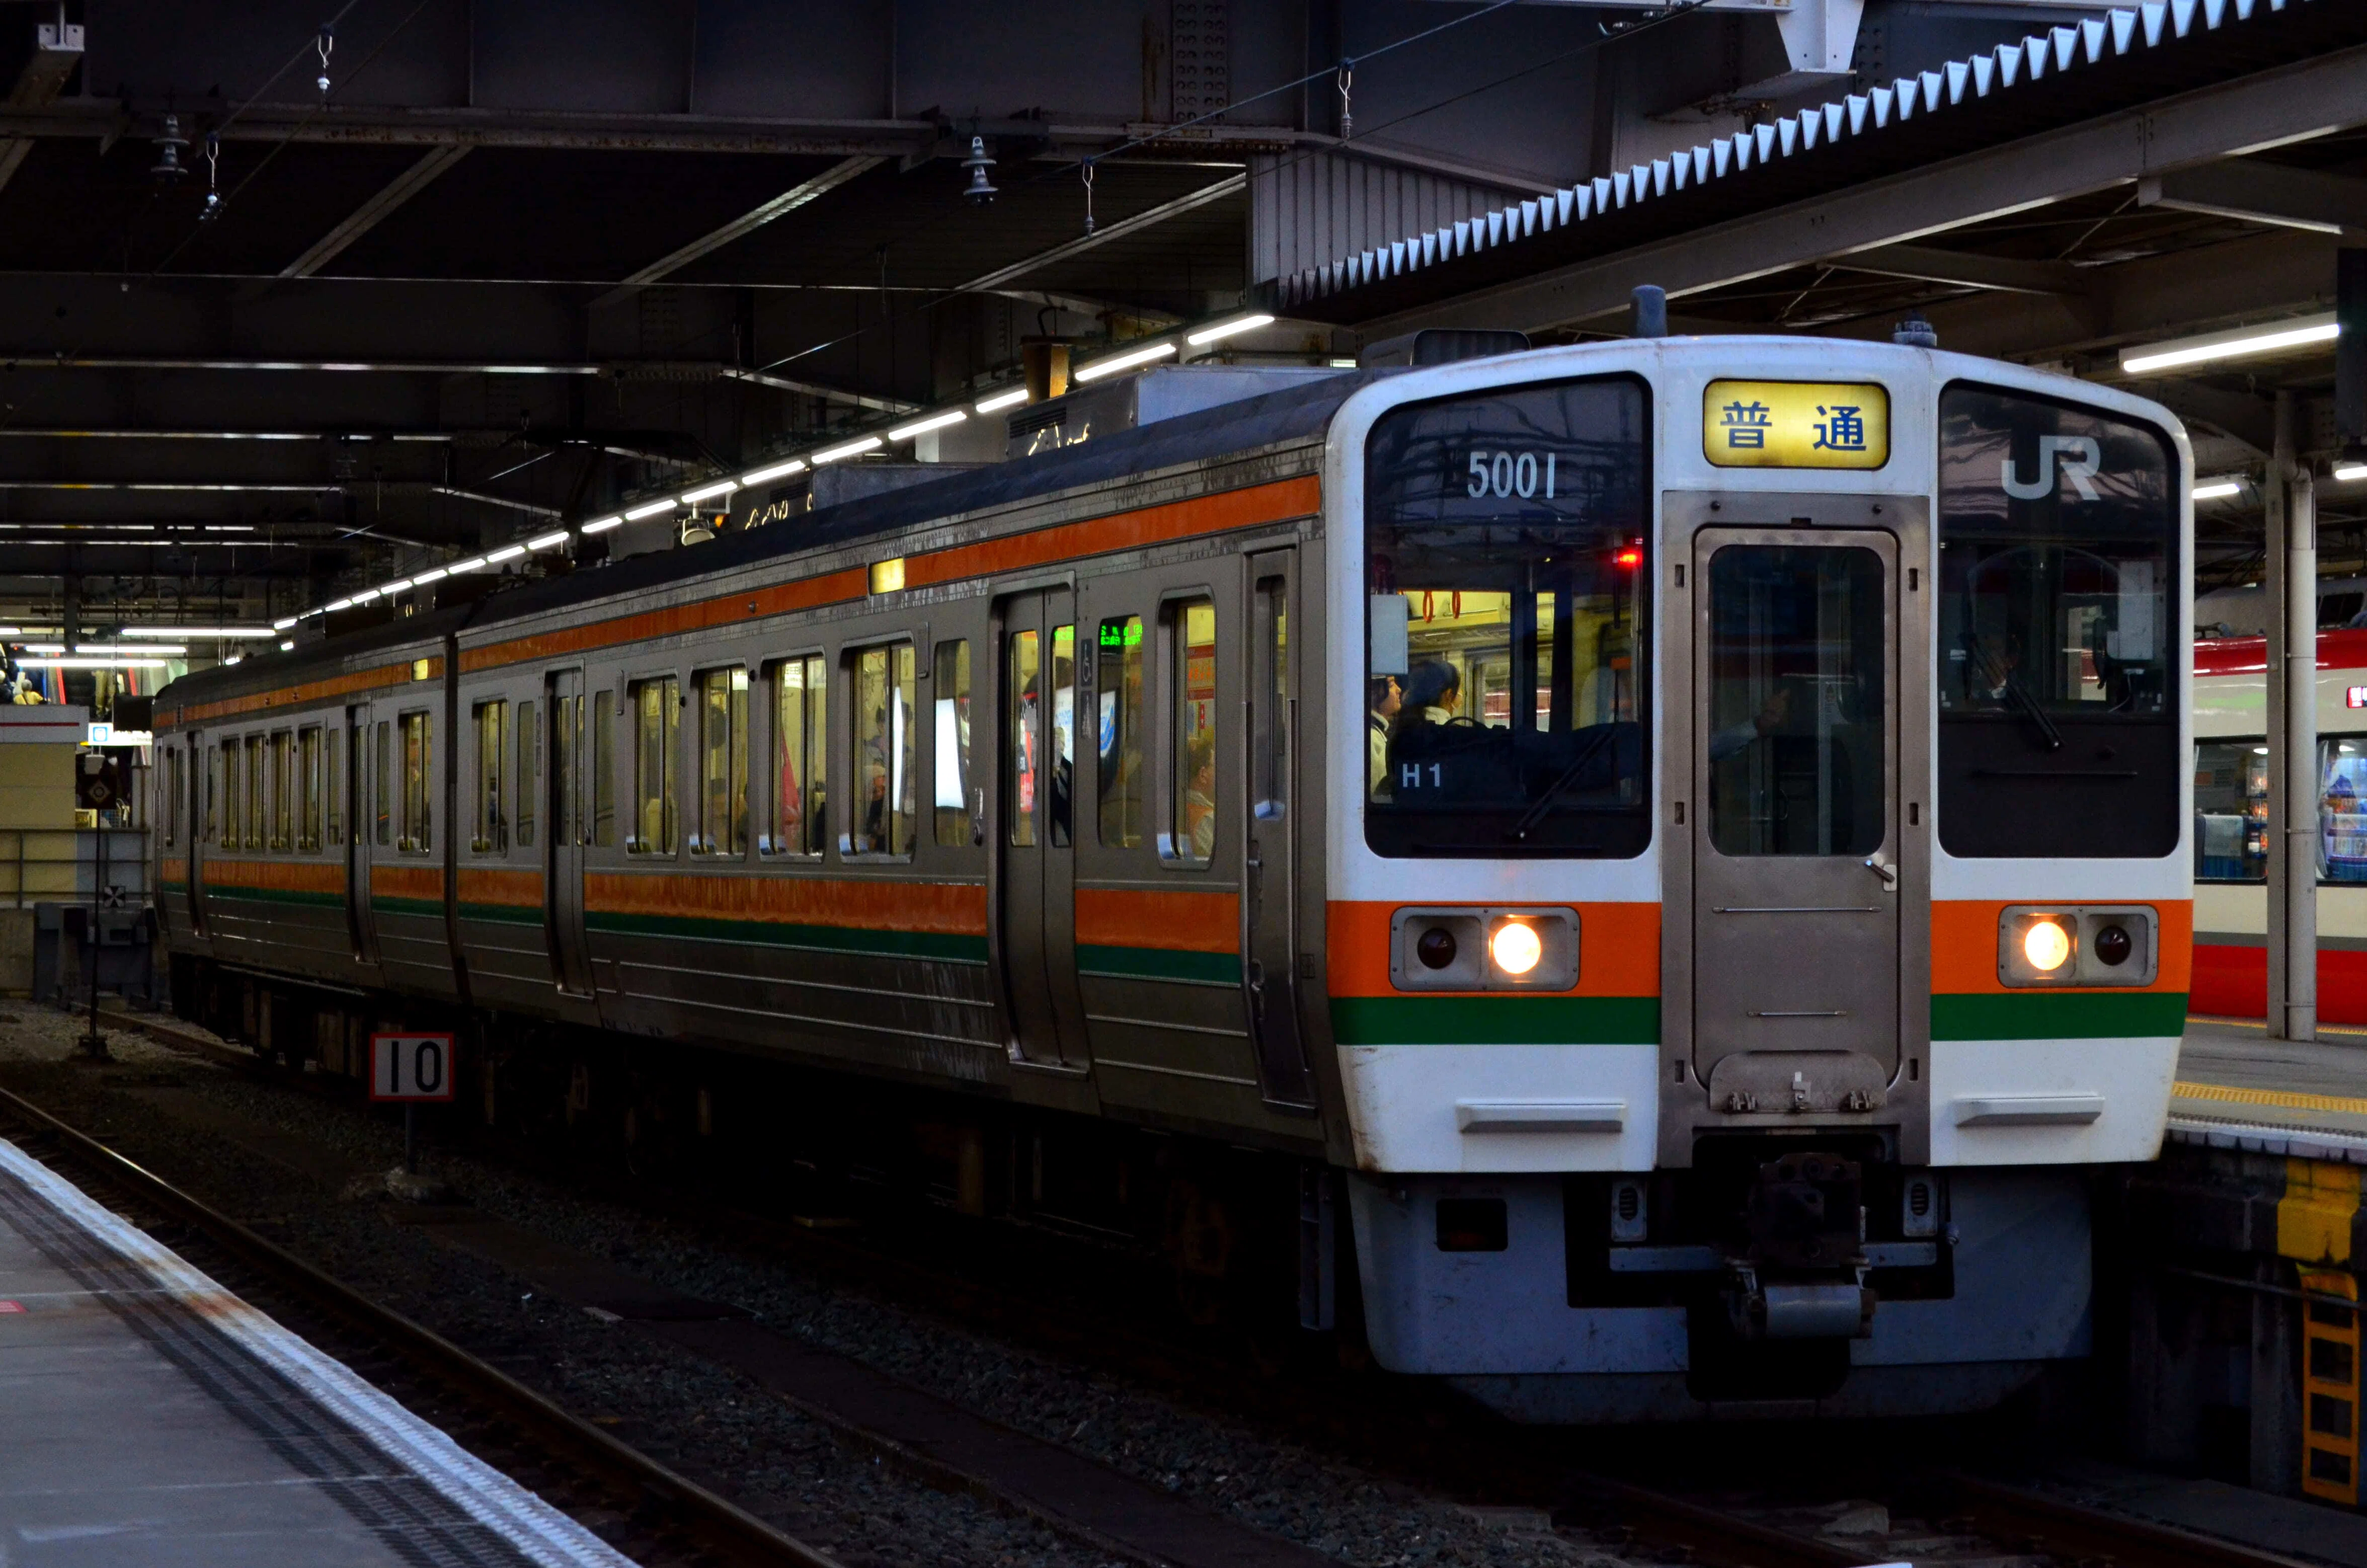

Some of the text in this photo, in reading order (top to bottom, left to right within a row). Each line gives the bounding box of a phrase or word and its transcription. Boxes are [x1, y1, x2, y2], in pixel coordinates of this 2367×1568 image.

[1467, 451, 1555, 498] 5001
[2001, 435, 2101, 501] JR
[390, 1041, 442, 1092] 10
